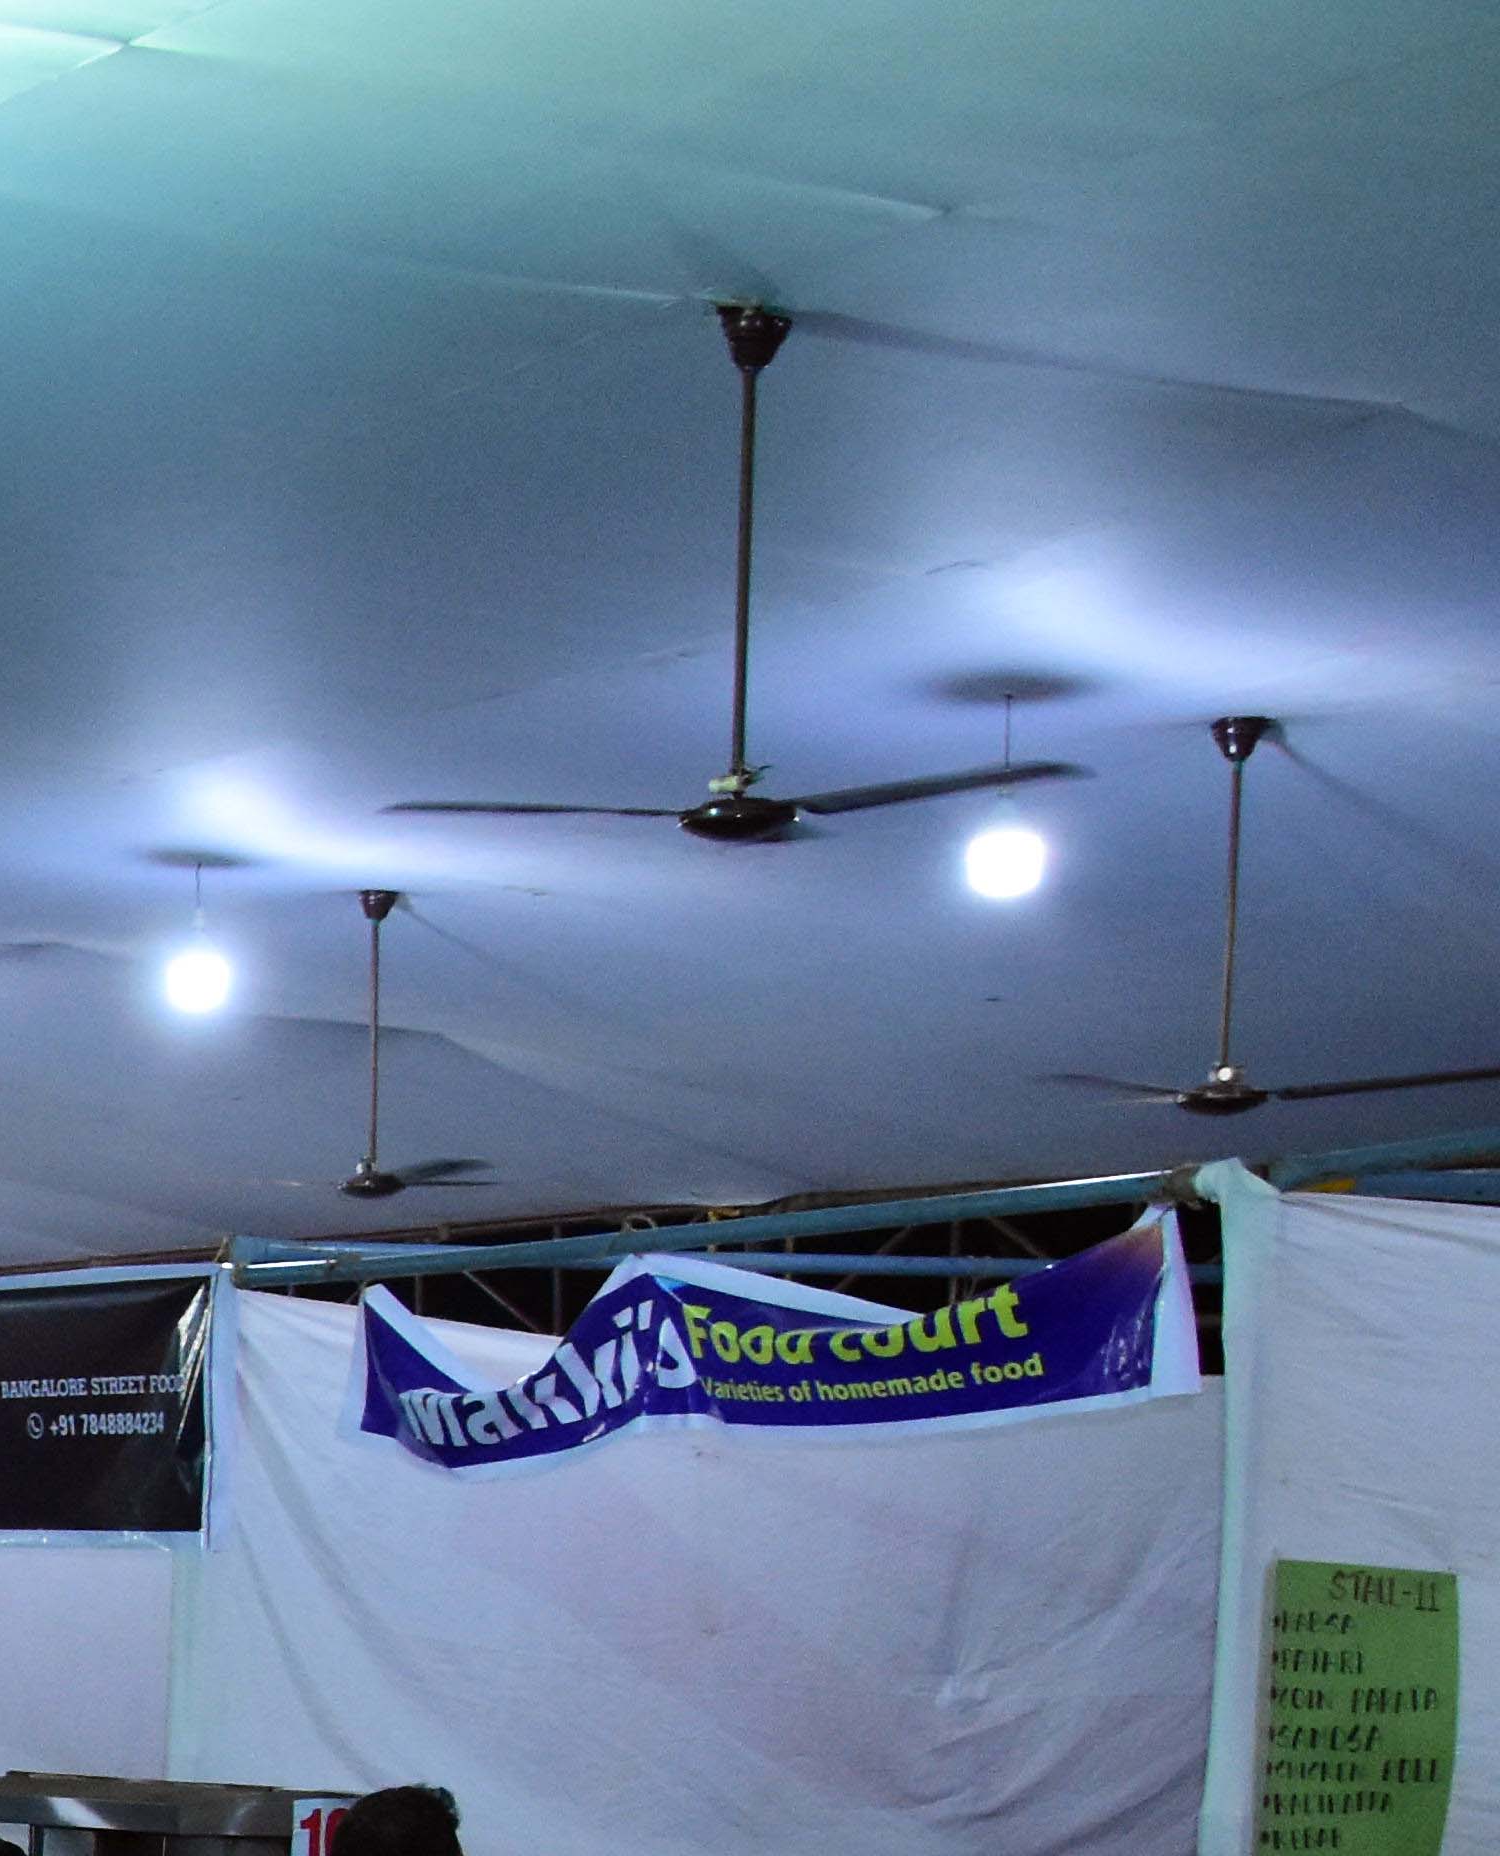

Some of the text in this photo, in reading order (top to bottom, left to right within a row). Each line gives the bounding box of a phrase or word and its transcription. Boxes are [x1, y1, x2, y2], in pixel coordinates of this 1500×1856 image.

[1, 1377, 88, 1399] BANGALORE
[91, 1375, 147, 1395] STREET
[701, 1352, 1045, 1402] Varieties of homemade food
[49, 1414, 76, 1436] +91
